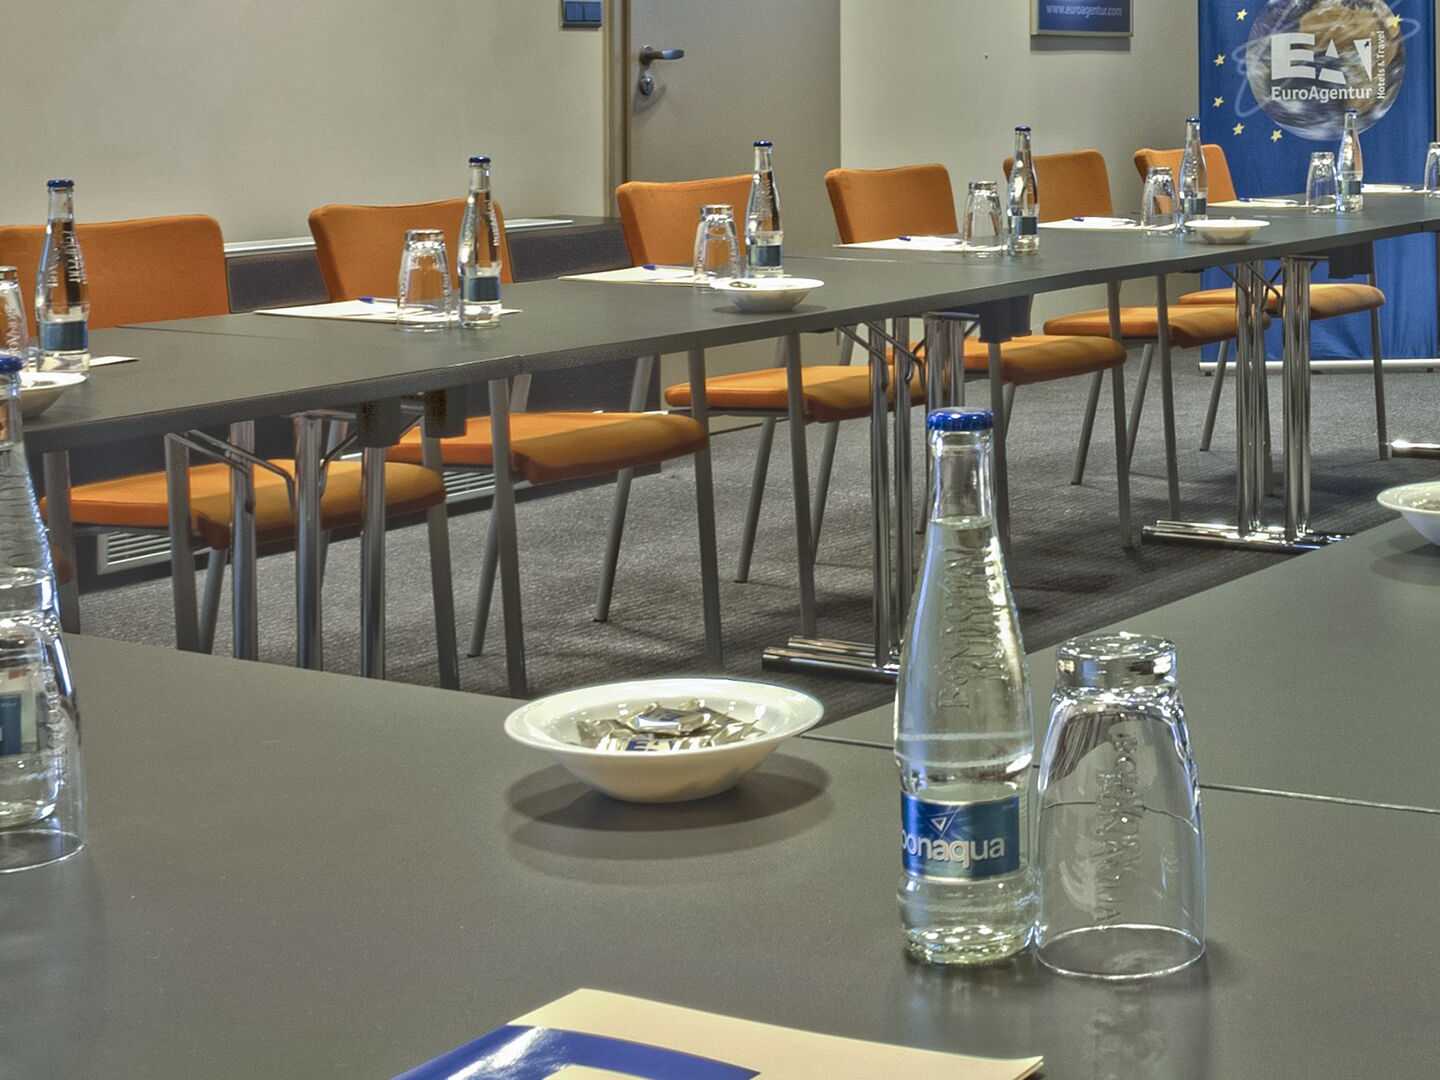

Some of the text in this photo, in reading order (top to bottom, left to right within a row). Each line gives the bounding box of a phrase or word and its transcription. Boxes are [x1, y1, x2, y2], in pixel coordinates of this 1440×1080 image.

[1046, 5, 1122, 18] www.euroagentur.com
[1376, 30, 1385, 60] Travel
[1271, 86, 1372, 103] EuroAgentur
[1376, 71, 1385, 99] Hotels
